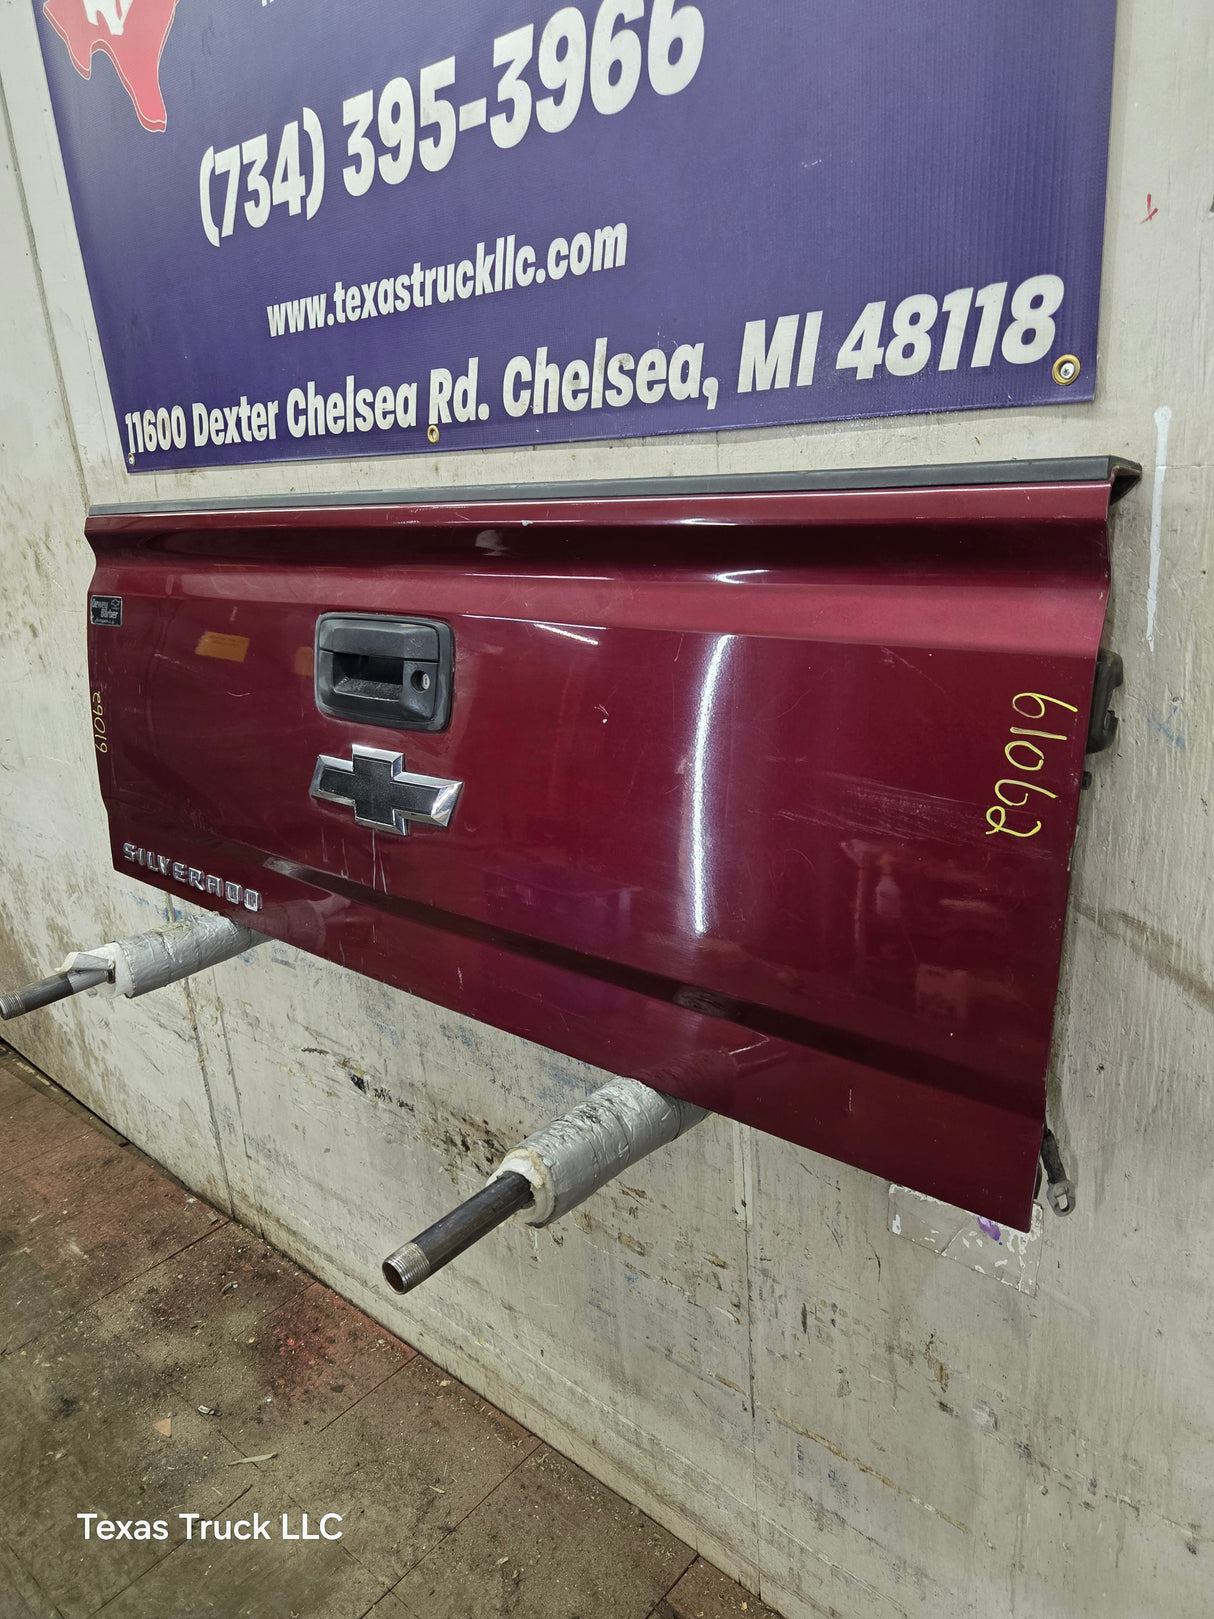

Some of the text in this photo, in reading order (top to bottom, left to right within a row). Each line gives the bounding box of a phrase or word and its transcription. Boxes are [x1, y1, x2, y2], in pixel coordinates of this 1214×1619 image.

[199, 0, 706, 248] (734) 395-3966
[267, 222, 628, 338] www.texastruckllc.com
[125, 273, 1066, 454] 11600 Dexter Chelsea Rd. Chelsea, MI 48118
[92, 691, 108, 753] 61062
[984, 692, 1079, 838] 61062
[122, 842, 262, 912] SILVERADO
